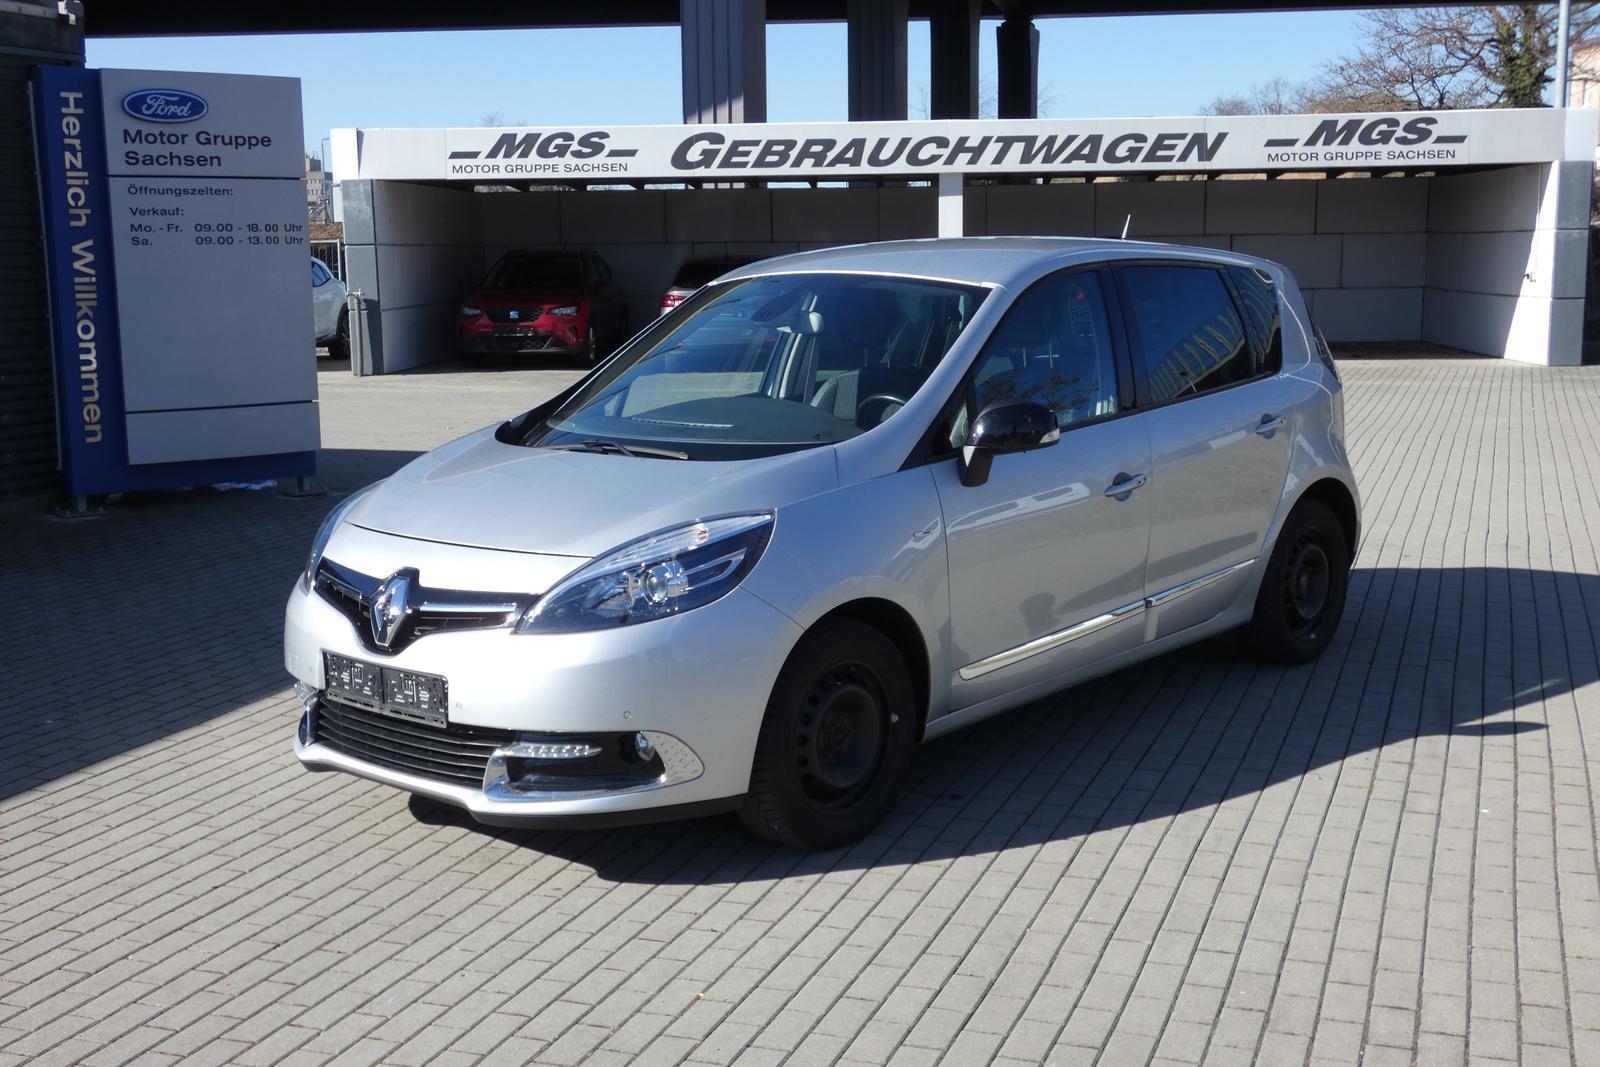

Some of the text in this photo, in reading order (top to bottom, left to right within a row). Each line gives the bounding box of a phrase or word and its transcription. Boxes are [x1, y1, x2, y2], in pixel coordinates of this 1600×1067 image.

[142, 94, 192, 116] Ford
[123, 129, 272, 150] Motor Gruppe
[670, 131, 1229, 170] GEBRAUCHTWAGEN
[1267, 149, 1457, 163] MOTOR GRUPPE SACHSEN
[124, 151, 222, 168] Sachsen
[452, 162, 628, 174] MOTOR GRUPPE SACHSEN
[127, 183, 233, 198] Öffnungszeiten:
[129, 207, 185, 217] Verkauf:
[130, 223, 156, 233] Mo.
[167, 223, 183, 233] Fr.
[194, 223, 233, 233] 09.00
[284, 223, 304, 233] Uhr
[131, 236, 153, 246] Sa.
[195, 236, 234, 246] 09.00
[285, 236, 304, 245] Uhr
[60, 91, 103, 444] Herzlich Willkommen
